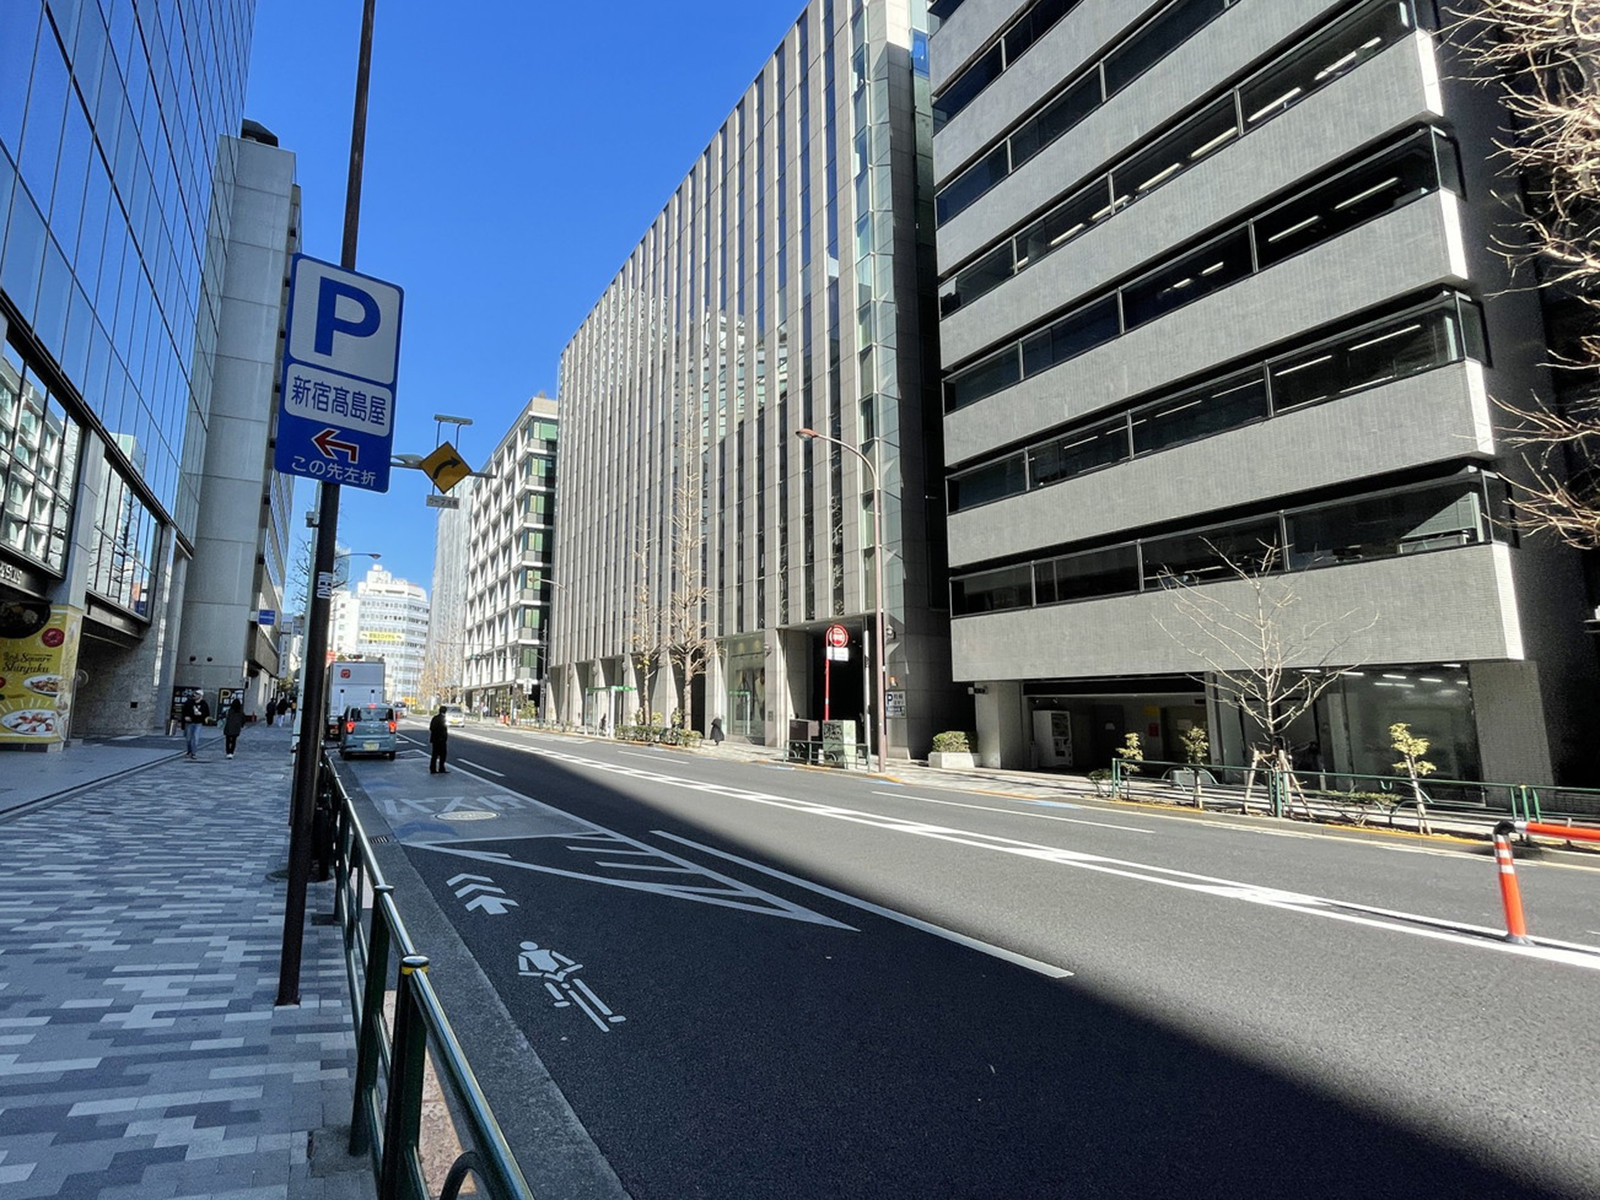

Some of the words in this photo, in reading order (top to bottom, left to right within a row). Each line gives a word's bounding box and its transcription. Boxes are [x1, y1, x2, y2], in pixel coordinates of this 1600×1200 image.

[314, 276, 381, 357] P
[291, 455, 376, 487] この先左折
